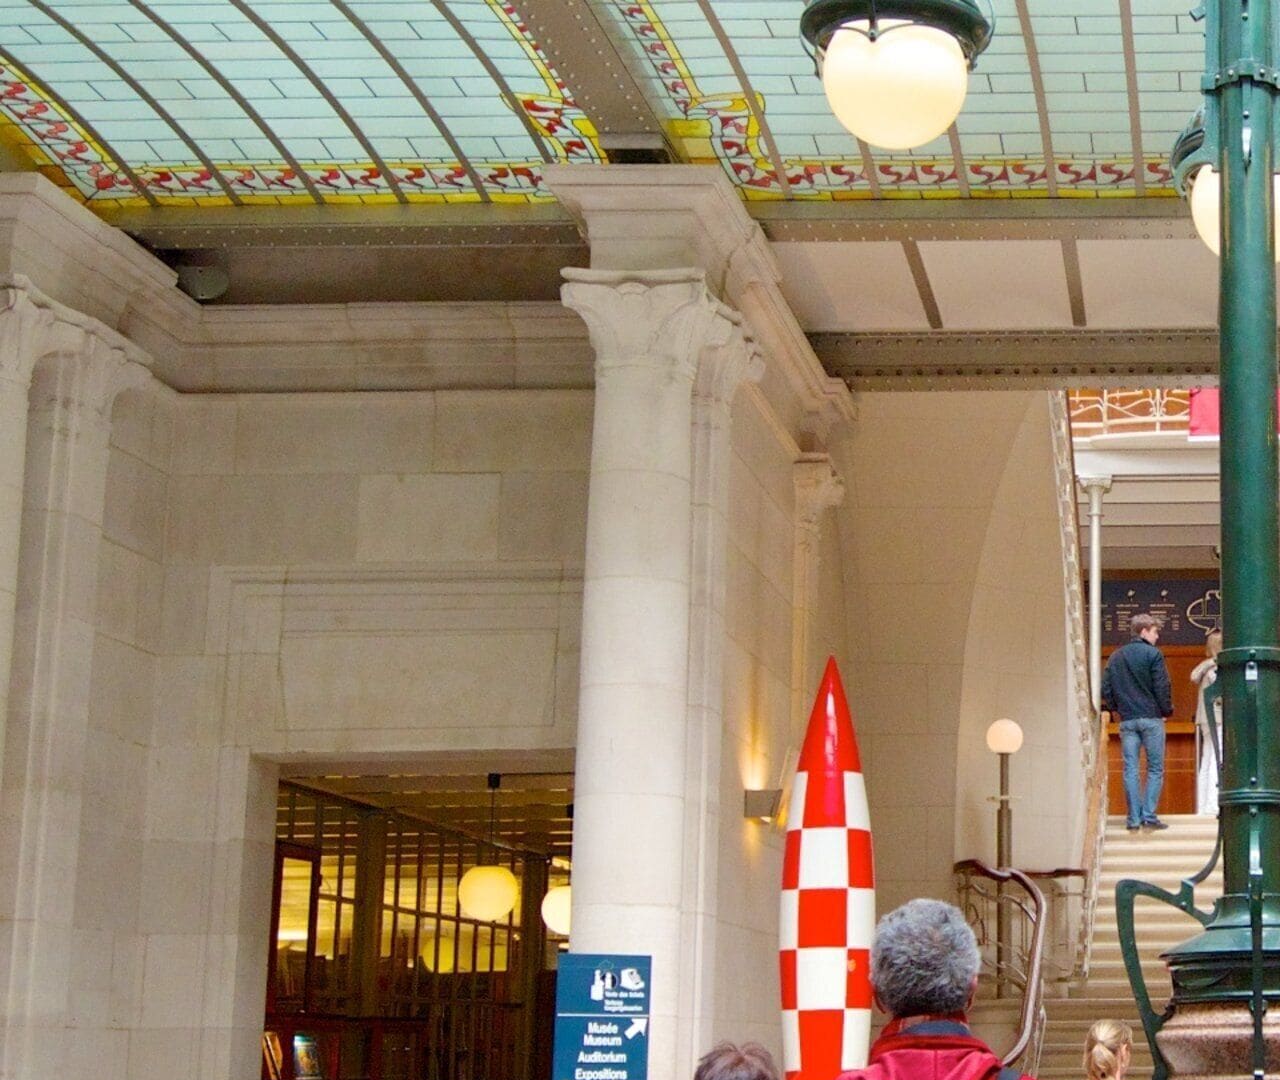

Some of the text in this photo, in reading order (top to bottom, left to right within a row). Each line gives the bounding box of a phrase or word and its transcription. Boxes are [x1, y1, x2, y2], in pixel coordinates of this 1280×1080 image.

[587, 1022, 619, 1034] Musée
[583, 1034, 622, 1046] Museum
[577, 1050, 627, 1063] Auditorium
